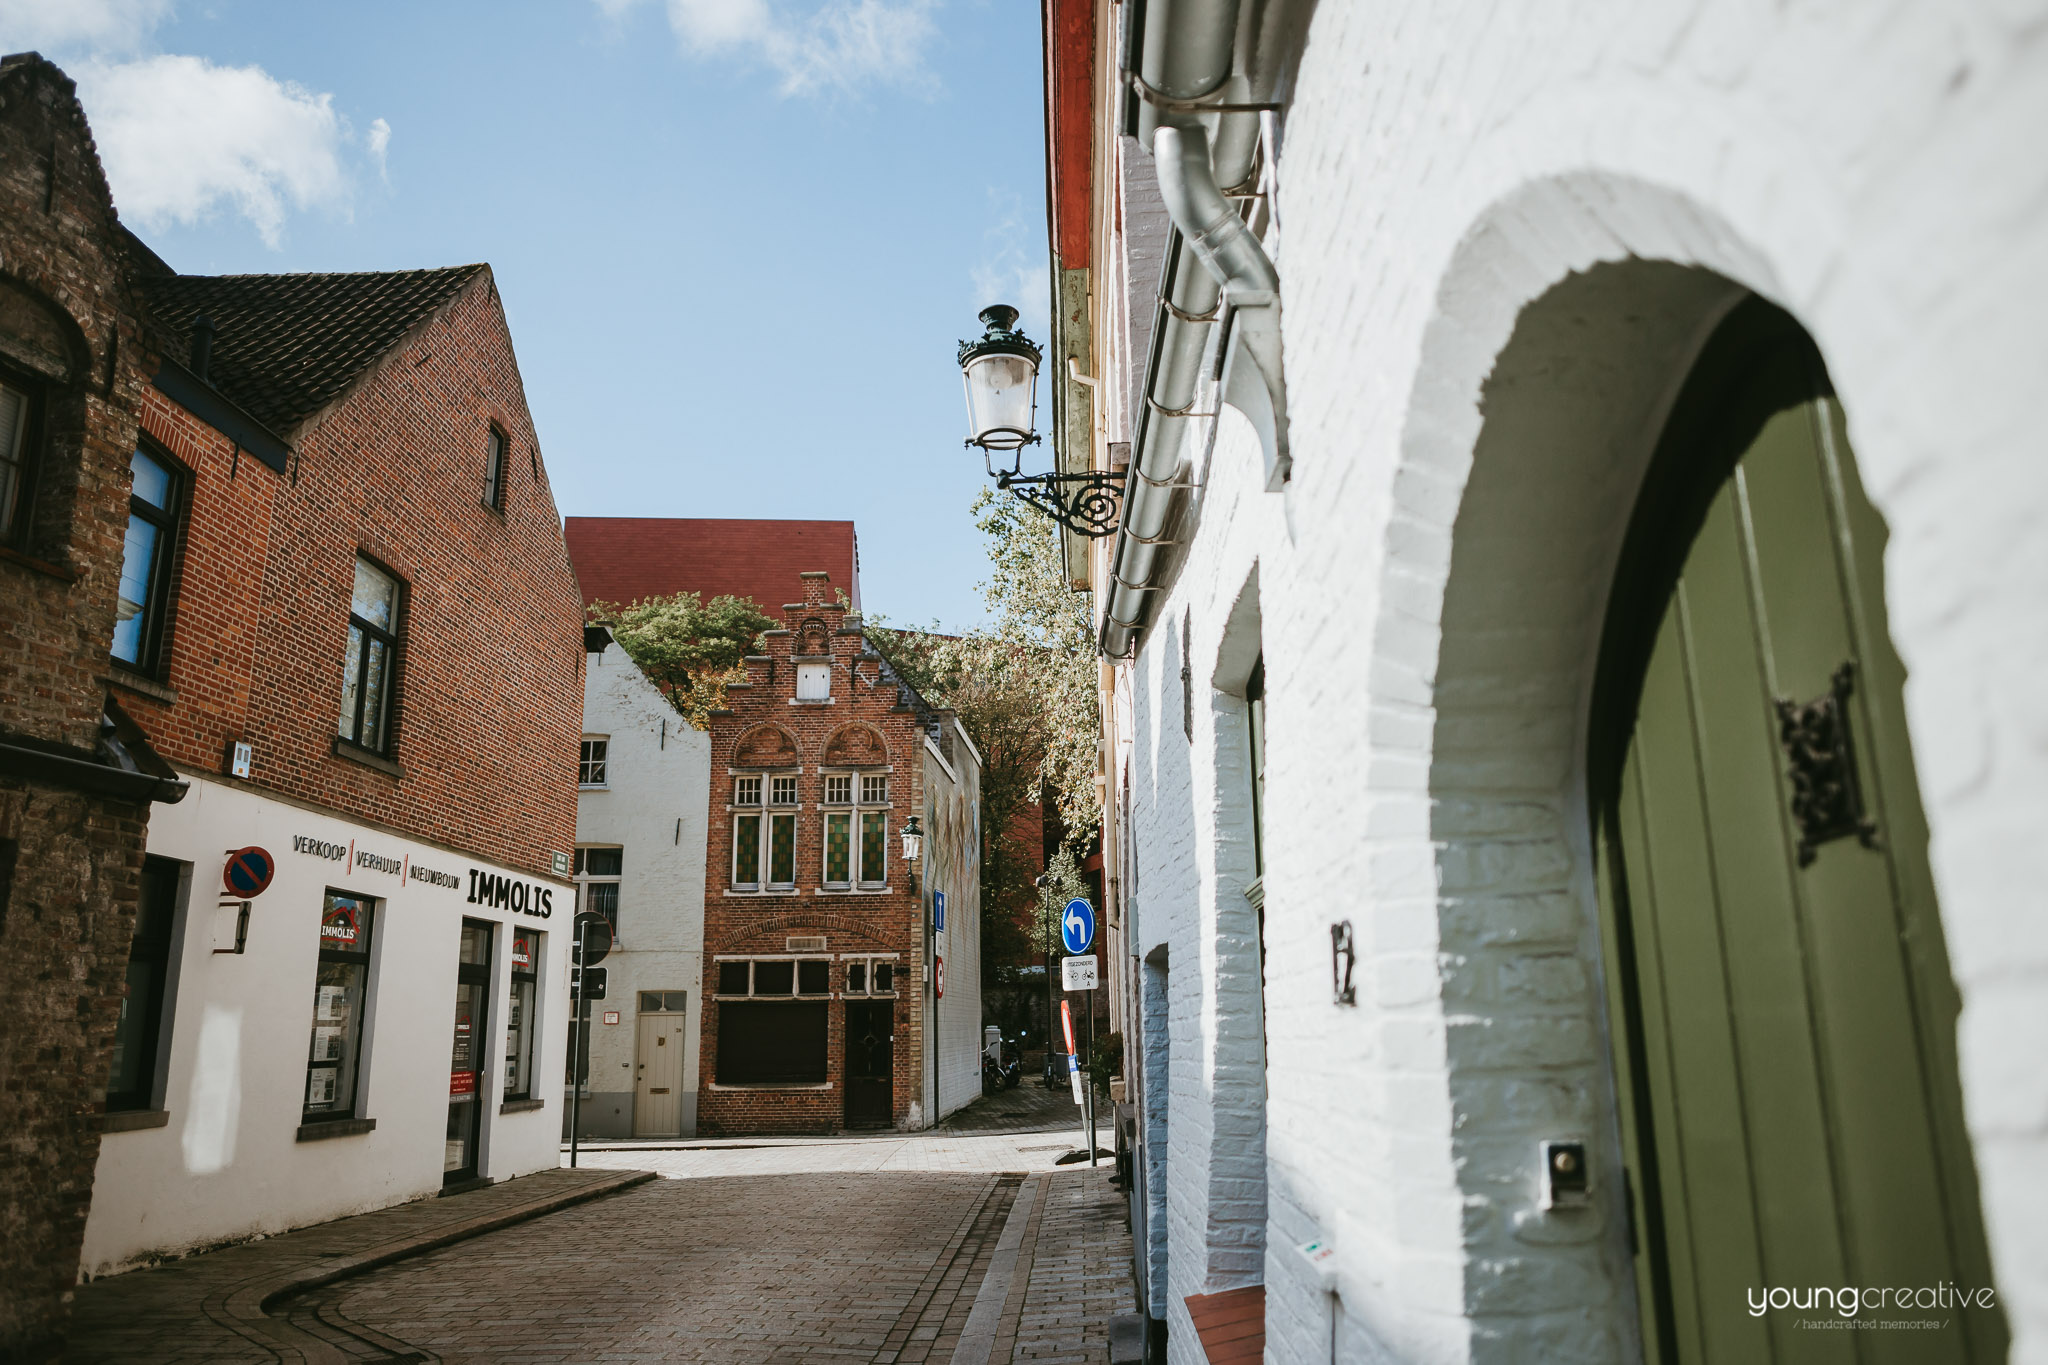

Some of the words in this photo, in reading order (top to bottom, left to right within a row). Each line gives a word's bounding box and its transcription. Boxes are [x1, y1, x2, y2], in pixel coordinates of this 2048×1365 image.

[293, 835, 347, 861] VERKOOP
[355, 850, 402, 875] VERHUUR
[409, 864, 461, 890] NIEUWBOUW
[467, 868, 552, 919] IMMOLIS
[321, 925, 355, 939] IMMOLIS
